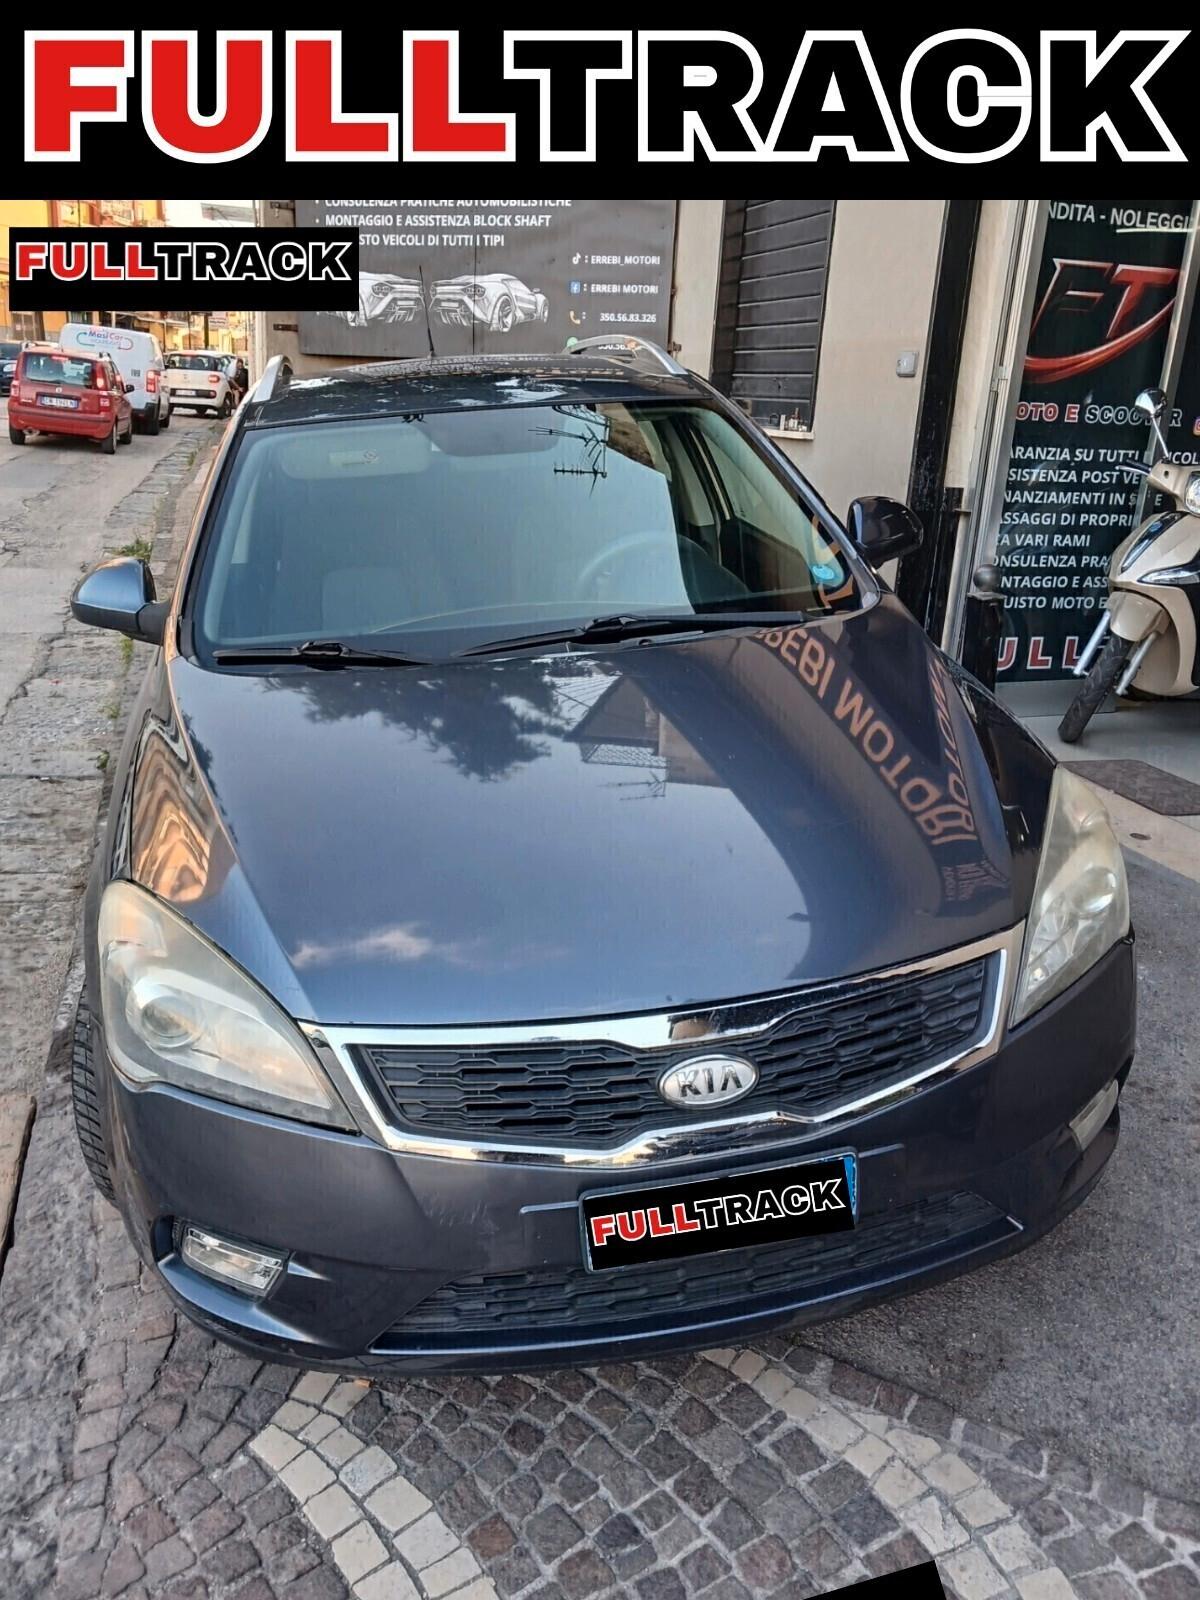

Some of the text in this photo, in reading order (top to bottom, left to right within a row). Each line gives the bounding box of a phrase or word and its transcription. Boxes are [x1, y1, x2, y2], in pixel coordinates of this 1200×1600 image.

[325, 214, 553, 227] MONTAGGIO E ASSISTENZA BLOCK SHAFT
[1047, 201, 1096, 223] NDITA
[1110, 207, 1190, 231] NOLEGGI
[358, 233, 380, 246] STO
[382, 234, 425, 247] VEICOLI
[427, 234, 440, 247] DI
[442, 234, 474, 247] TUTTI
[482, 234, 505, 247] TIPI
[590, 283, 659, 295] ERREBI MOTORI
[1015, 402, 1059, 422] OTO
[1064, 404, 1080, 423] E
[1010, 446, 1071, 461] RANZIA
[1073, 448, 1095, 461] SU
[1008, 468, 1141, 485] SISTENZA POST VE
[1004, 490, 1106, 505] NANZIAMENTI
[1109, 492, 1126, 506] IN
[1000, 511, 1133, 527] SSAGGI DI PROPRI
[1015, 533, 1049, 547] VARI
[1053, 534, 1091, 548] RAMI
[1081, 555, 1109, 568] PRA
[1001, 575, 1109, 589] NTAGGIO E ASS
[1004, 595, 1048, 610] UISTO
[1051, 596, 1096, 610] MOTO
[996, 636, 1081, 671] ULL
[675, 1063, 744, 1098] KIA
